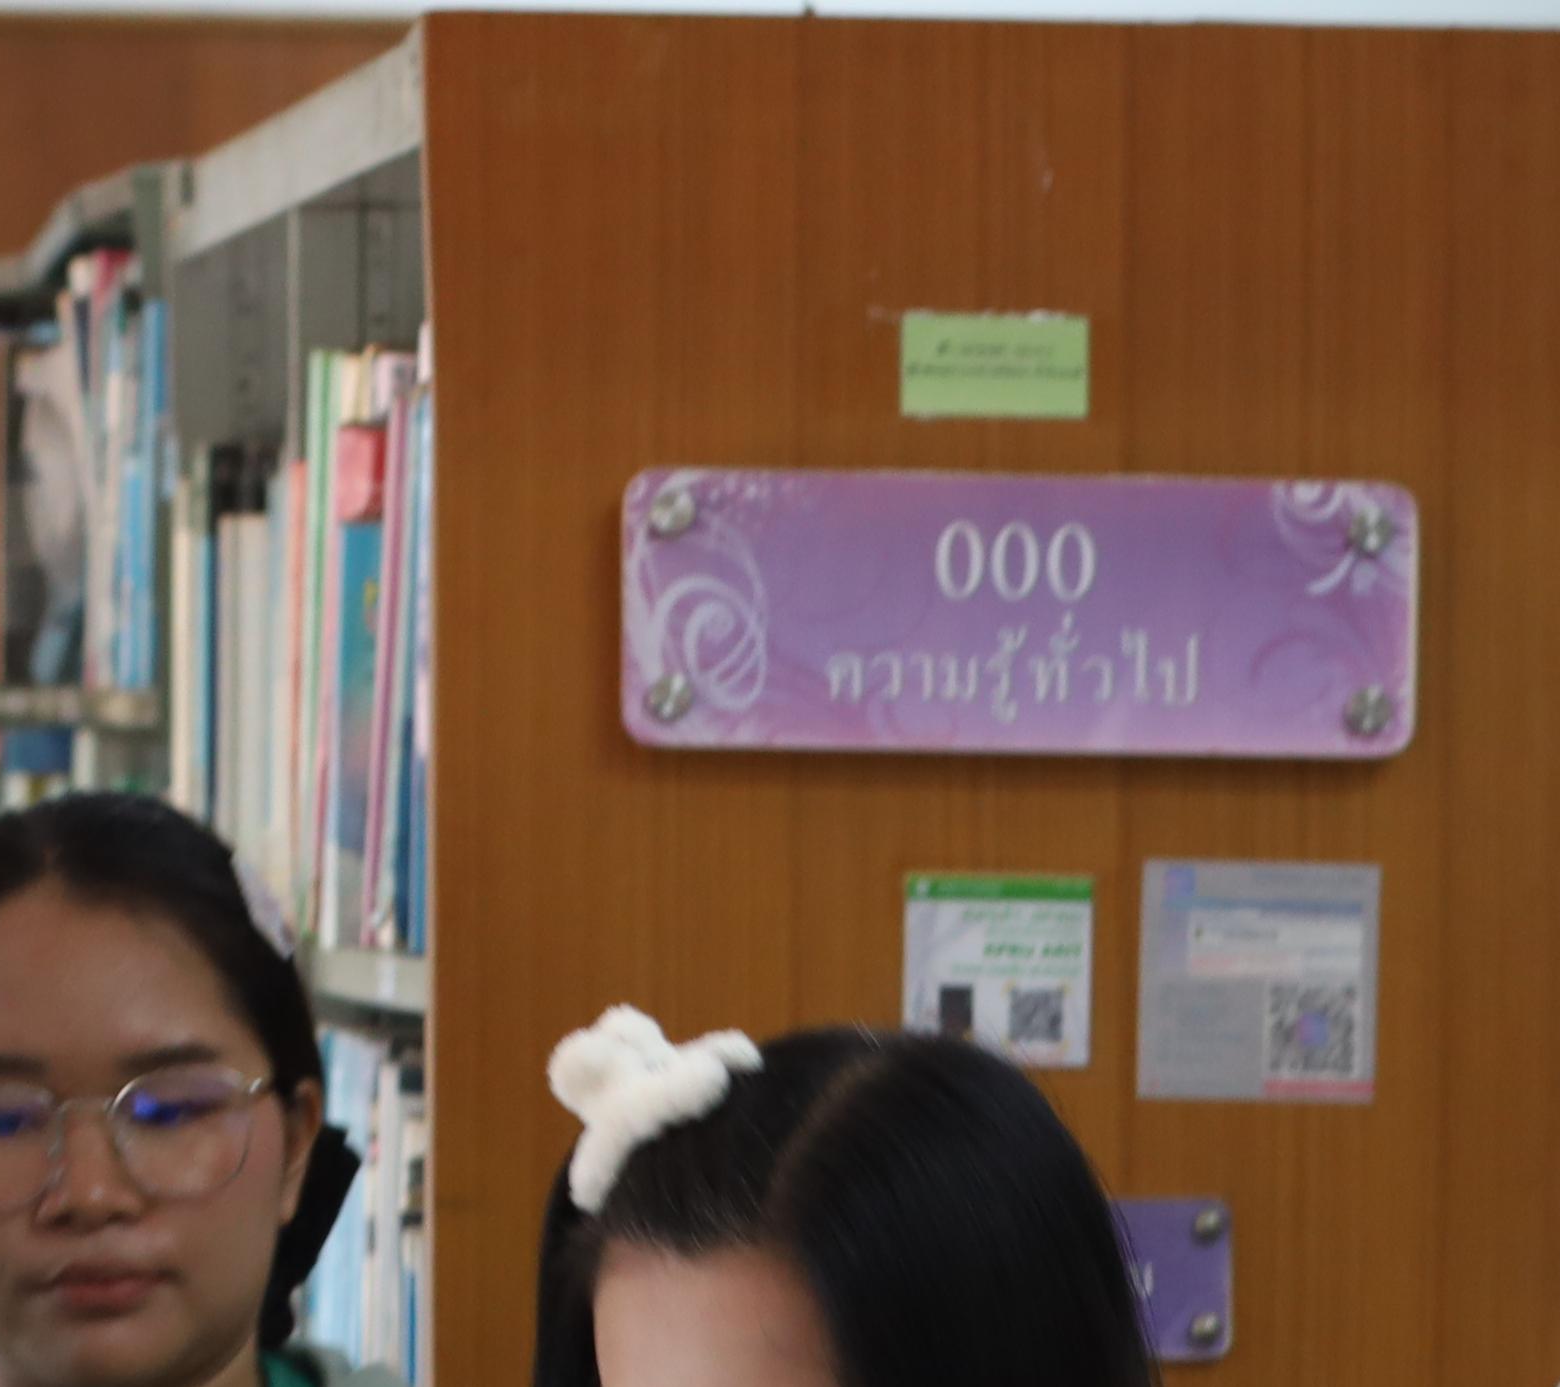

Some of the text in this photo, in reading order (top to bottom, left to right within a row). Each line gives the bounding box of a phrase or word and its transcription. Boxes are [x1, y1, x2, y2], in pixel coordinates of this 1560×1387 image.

[935, 519, 1096, 602] 000
[826, 609, 1200, 724] ความรู้ทั่วไป
